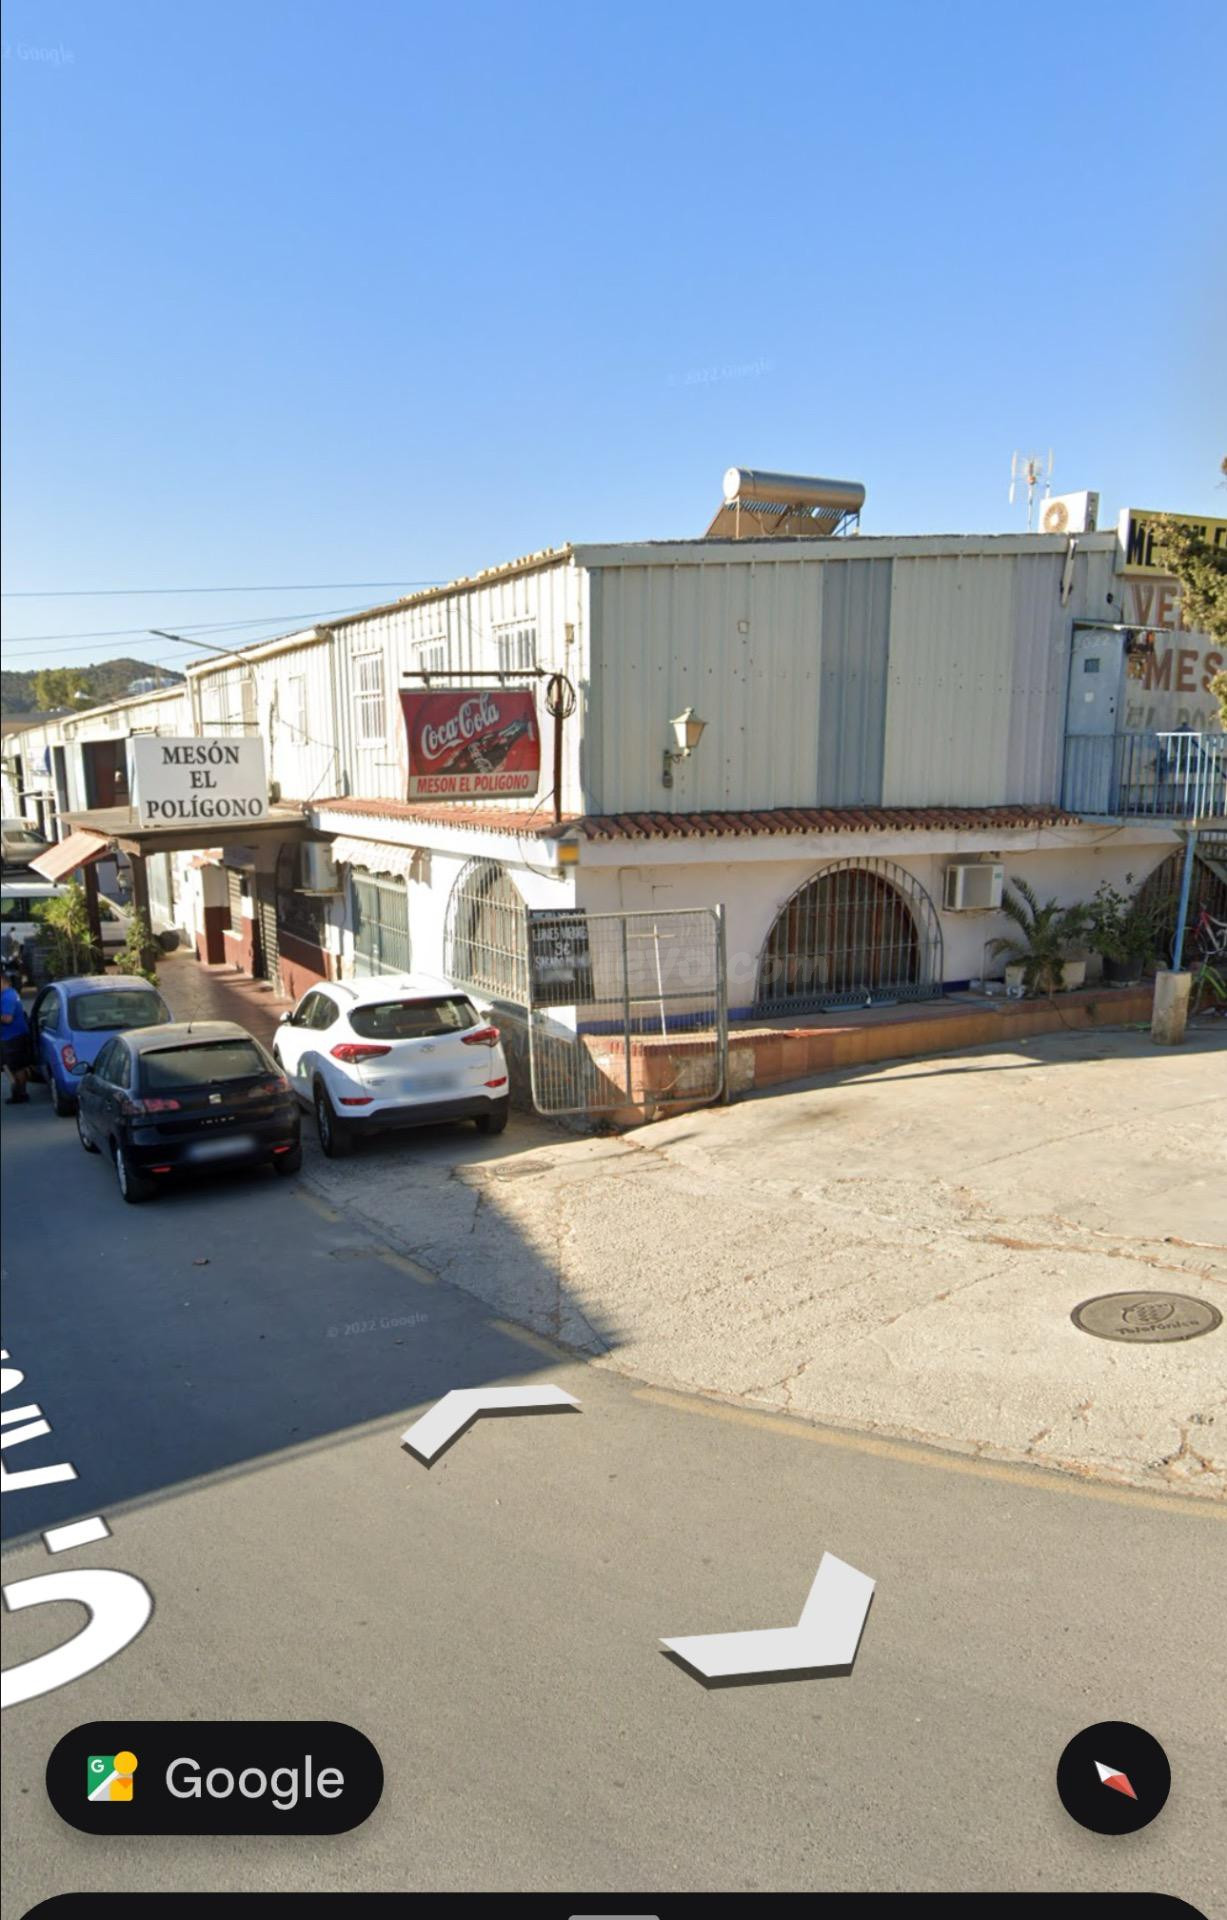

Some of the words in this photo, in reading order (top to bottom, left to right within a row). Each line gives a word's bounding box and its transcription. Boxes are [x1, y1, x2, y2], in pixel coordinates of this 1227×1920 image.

[161, 741, 240, 765] MESÓN
[189, 770, 217, 789] EL
[416, 777, 456, 794] MESON
[459, 777, 471, 793] EL
[474, 774, 529, 792] POLIGONO
[146, 795, 263, 819] POLÍGONO
